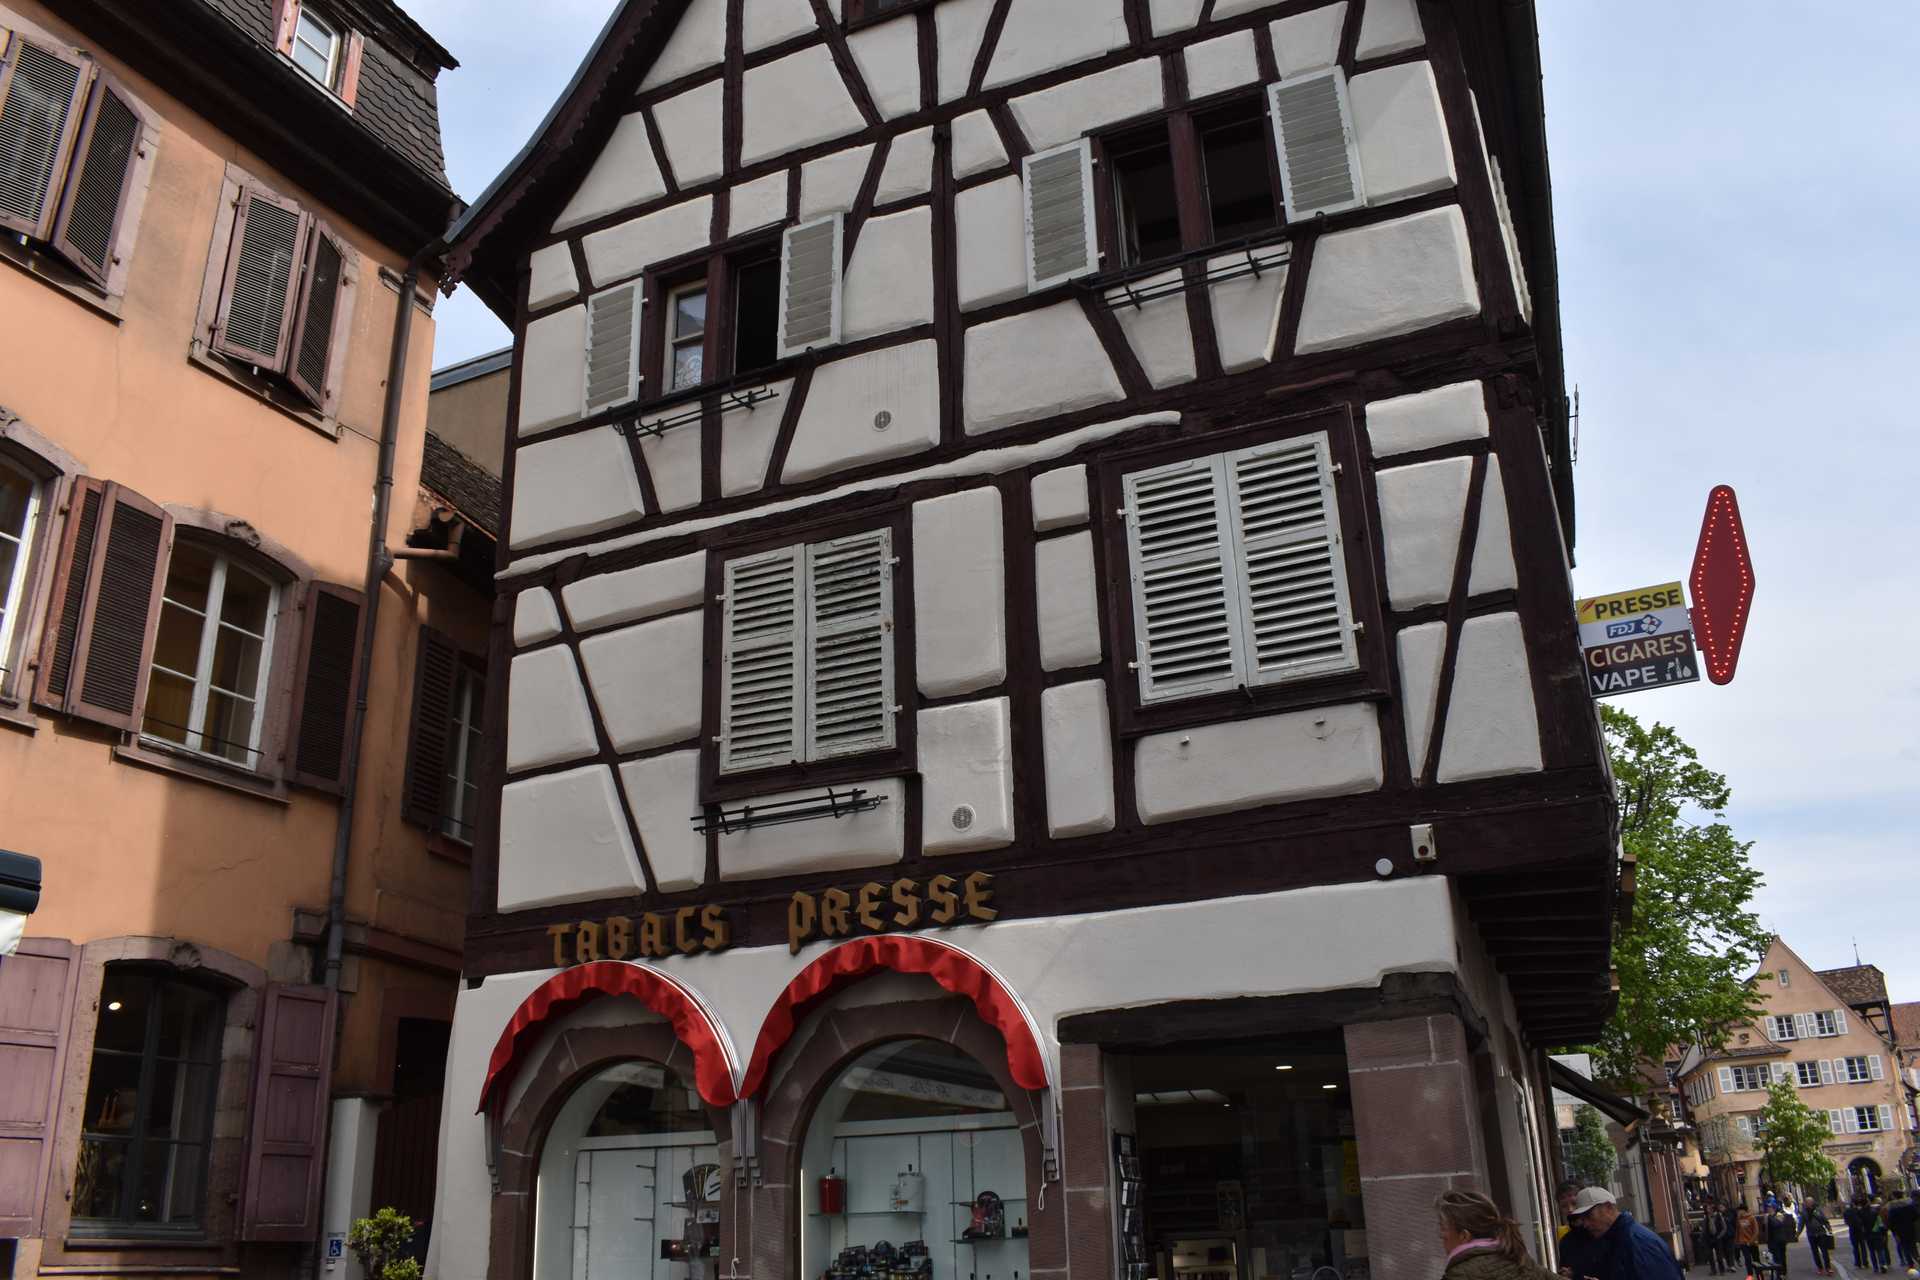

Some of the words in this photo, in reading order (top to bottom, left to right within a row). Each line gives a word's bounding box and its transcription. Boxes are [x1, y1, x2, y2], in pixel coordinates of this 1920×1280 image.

[1595, 589, 1680, 619] PRESSE
[1609, 624, 1635, 637] FDJ
[1590, 634, 1687, 668] CIGARES
[1593, 665, 1657, 691] VAPE
[546, 904, 732, 966] TABACS
[788, 871, 998, 955] PRESSE
